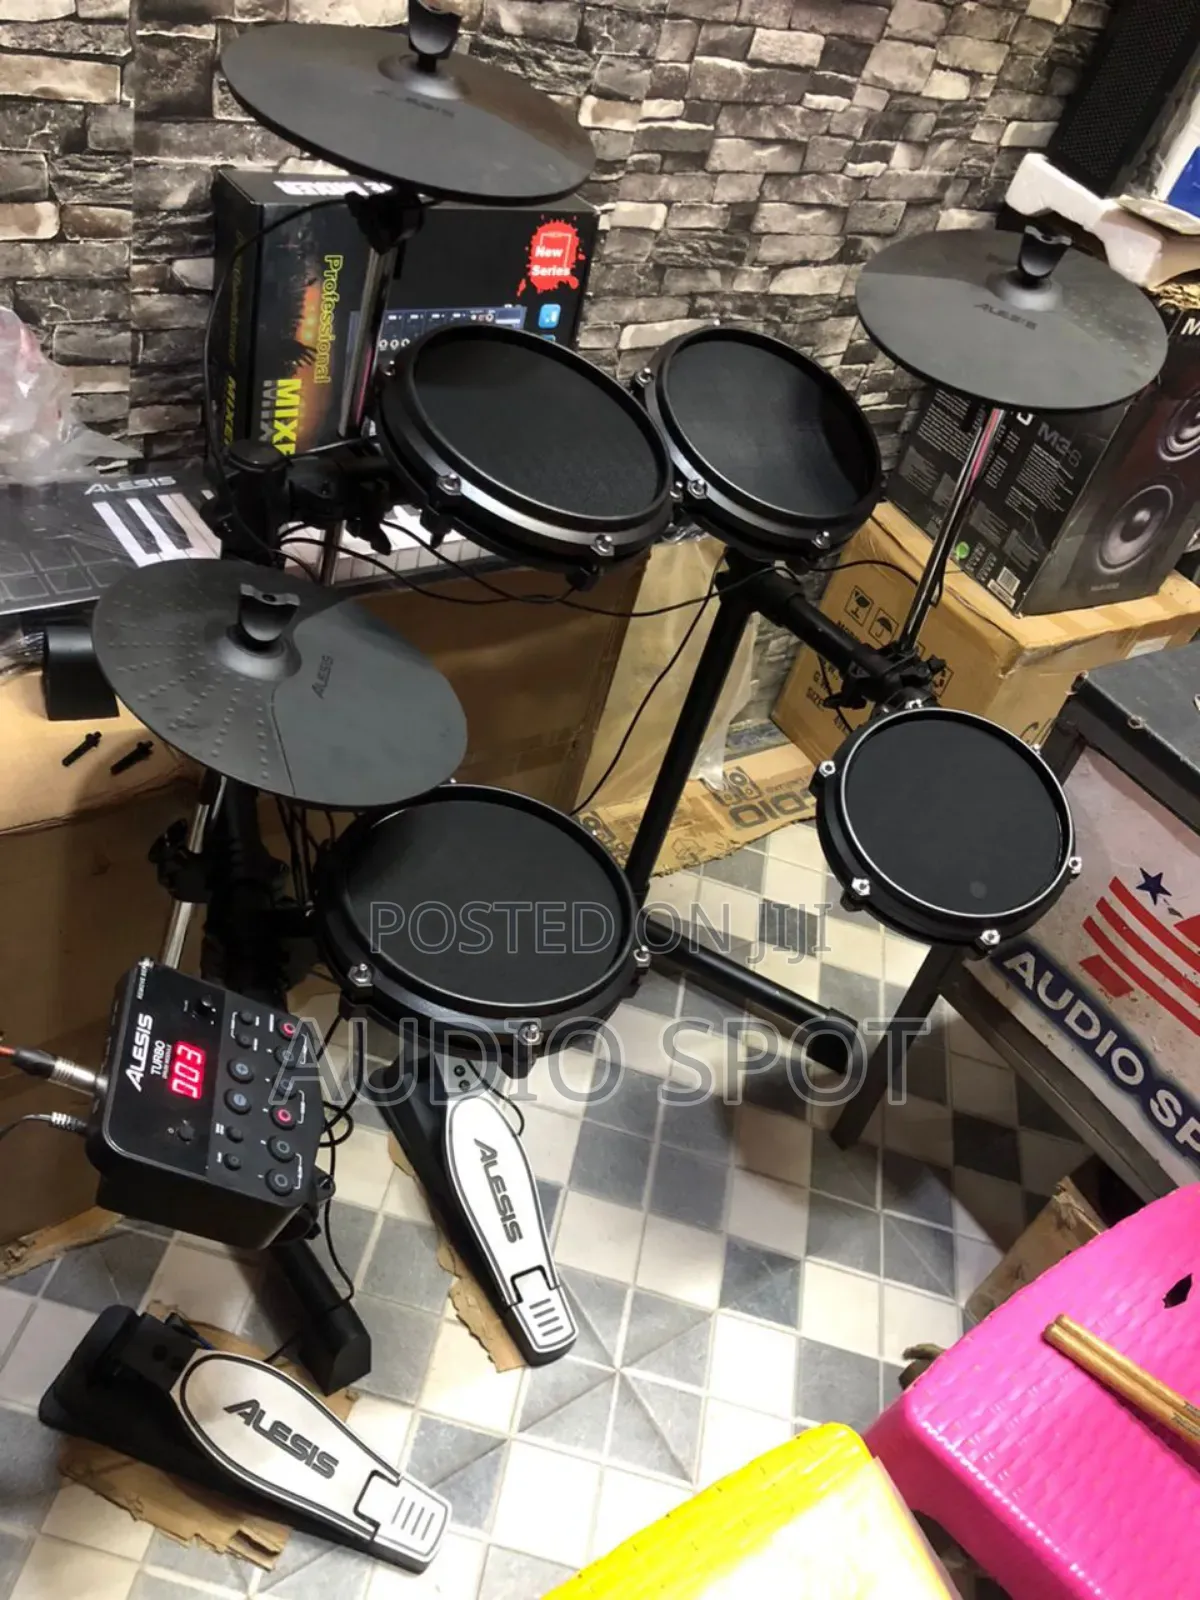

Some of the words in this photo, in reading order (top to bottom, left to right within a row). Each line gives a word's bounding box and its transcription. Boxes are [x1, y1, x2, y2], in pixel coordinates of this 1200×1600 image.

[531, 264, 571, 276] Series
[534, 245, 564, 258] New
[313, 254, 344, 384] Professional
[84, 476, 177, 496] ALESIS
[311, 654, 334, 700] ALESIS
[1003, 951, 1145, 1086] AUDIO
[125, 1012, 153, 1092] ALESIS
[150, 1039, 166, 1076] TURBO
[473, 1137, 525, 1244] ALESIS
[222, 1398, 340, 1480] ALESIS
